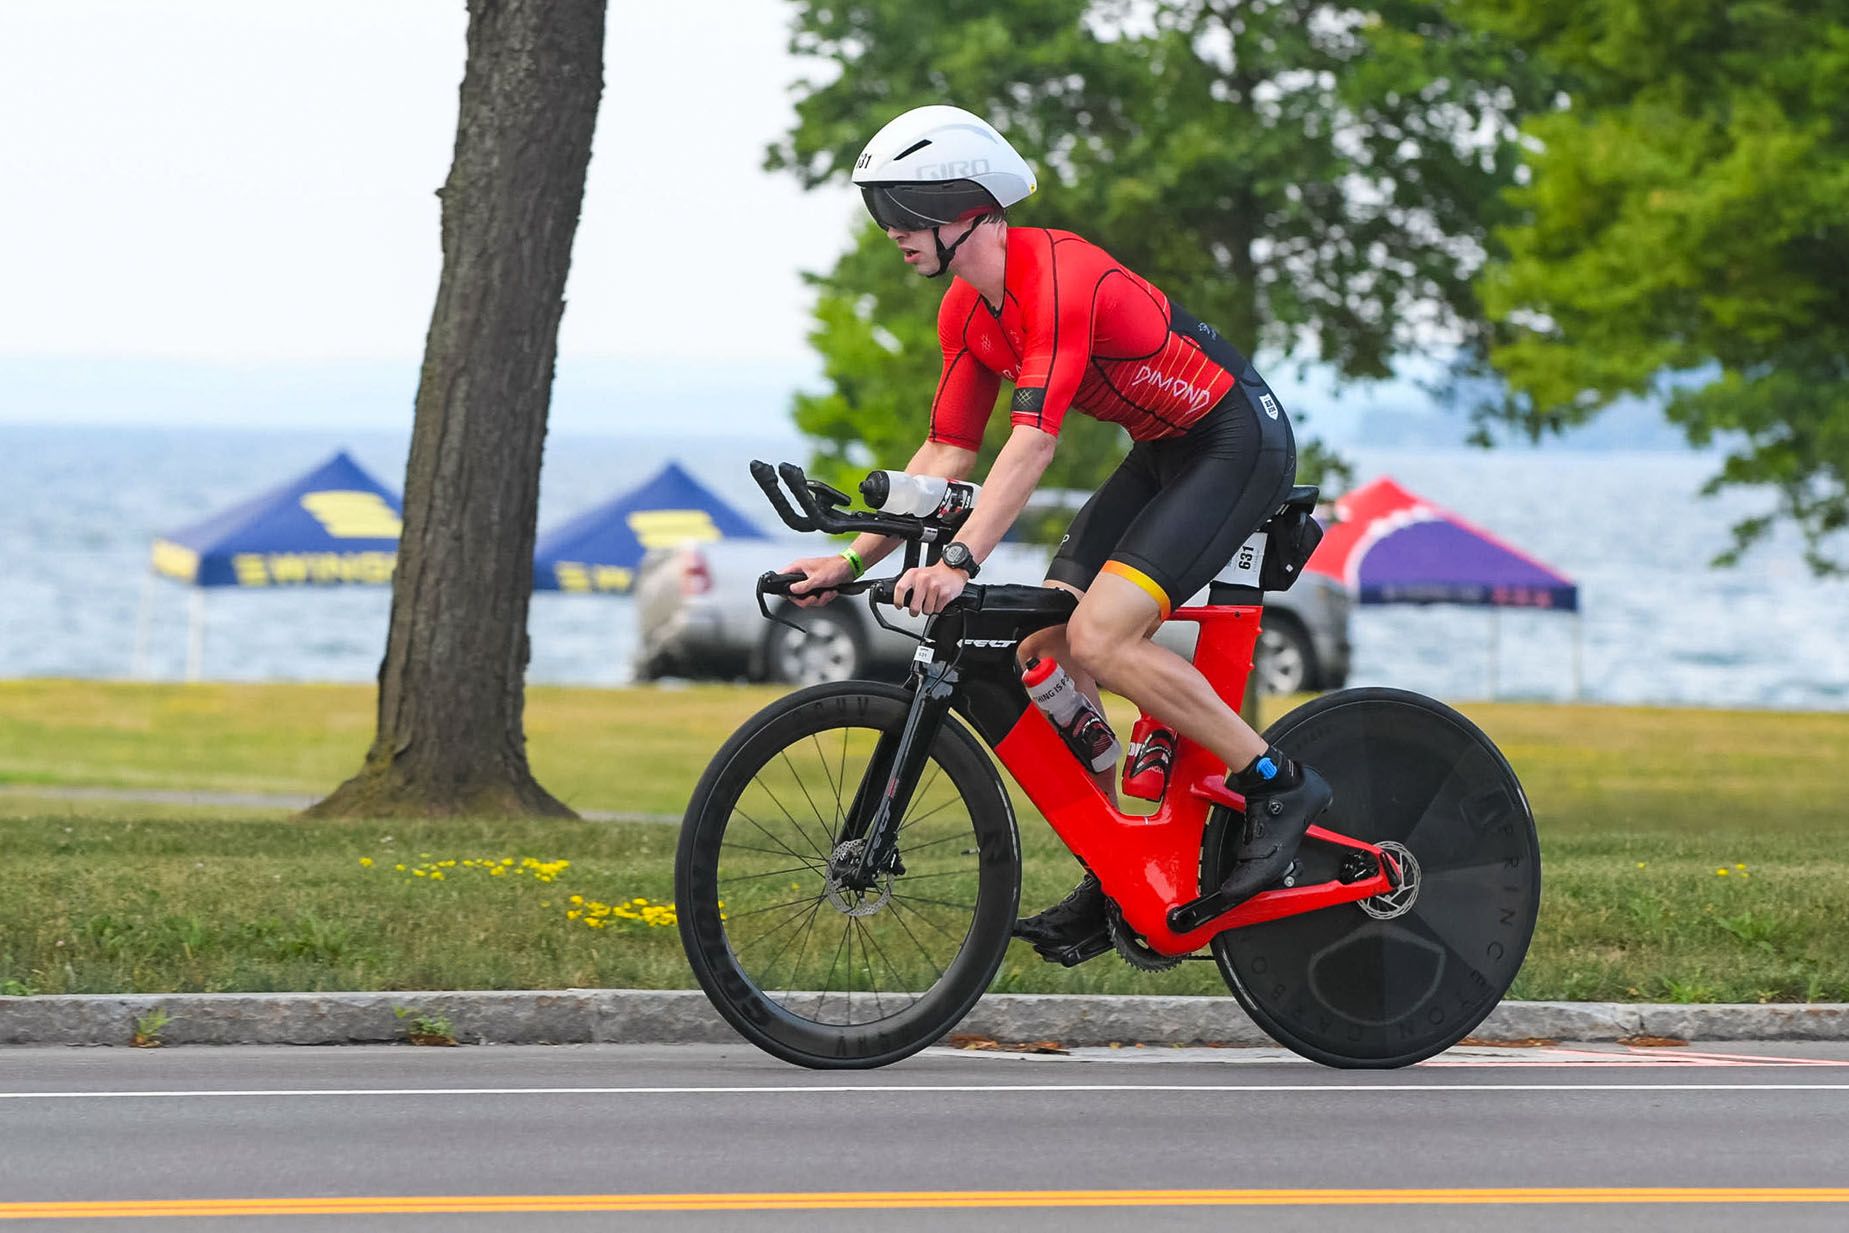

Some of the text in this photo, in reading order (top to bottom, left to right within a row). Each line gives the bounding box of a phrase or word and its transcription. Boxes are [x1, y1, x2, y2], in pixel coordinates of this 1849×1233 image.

[916, 159, 990, 180] GIRO
[1131, 365, 1210, 415] DIMOND
[1238, 545, 1254, 570] 631
[1054, 683, 1064, 694] IS
